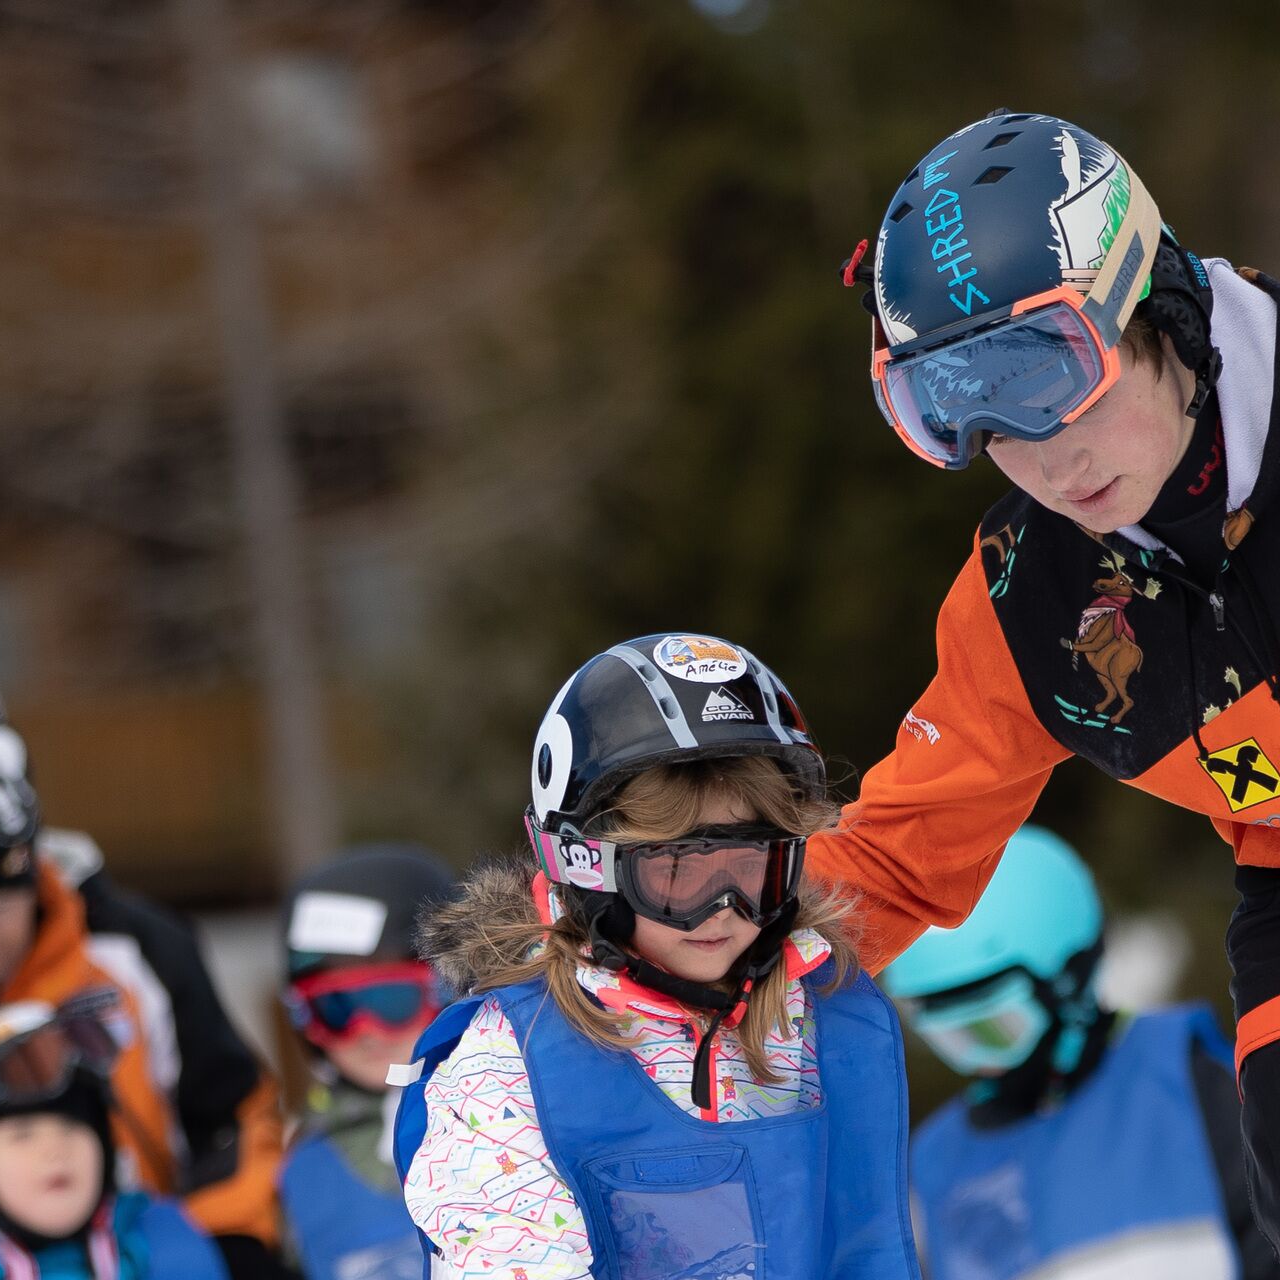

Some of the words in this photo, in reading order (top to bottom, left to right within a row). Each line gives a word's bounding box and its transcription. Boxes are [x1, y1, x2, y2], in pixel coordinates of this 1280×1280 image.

[924, 188, 991, 316] SHRED
[1186, 251, 1210, 288] SHRED
[1112, 247, 1141, 302] SHRED
[701, 712, 755, 722] SWAIN
[705, 704, 744, 713] COX
